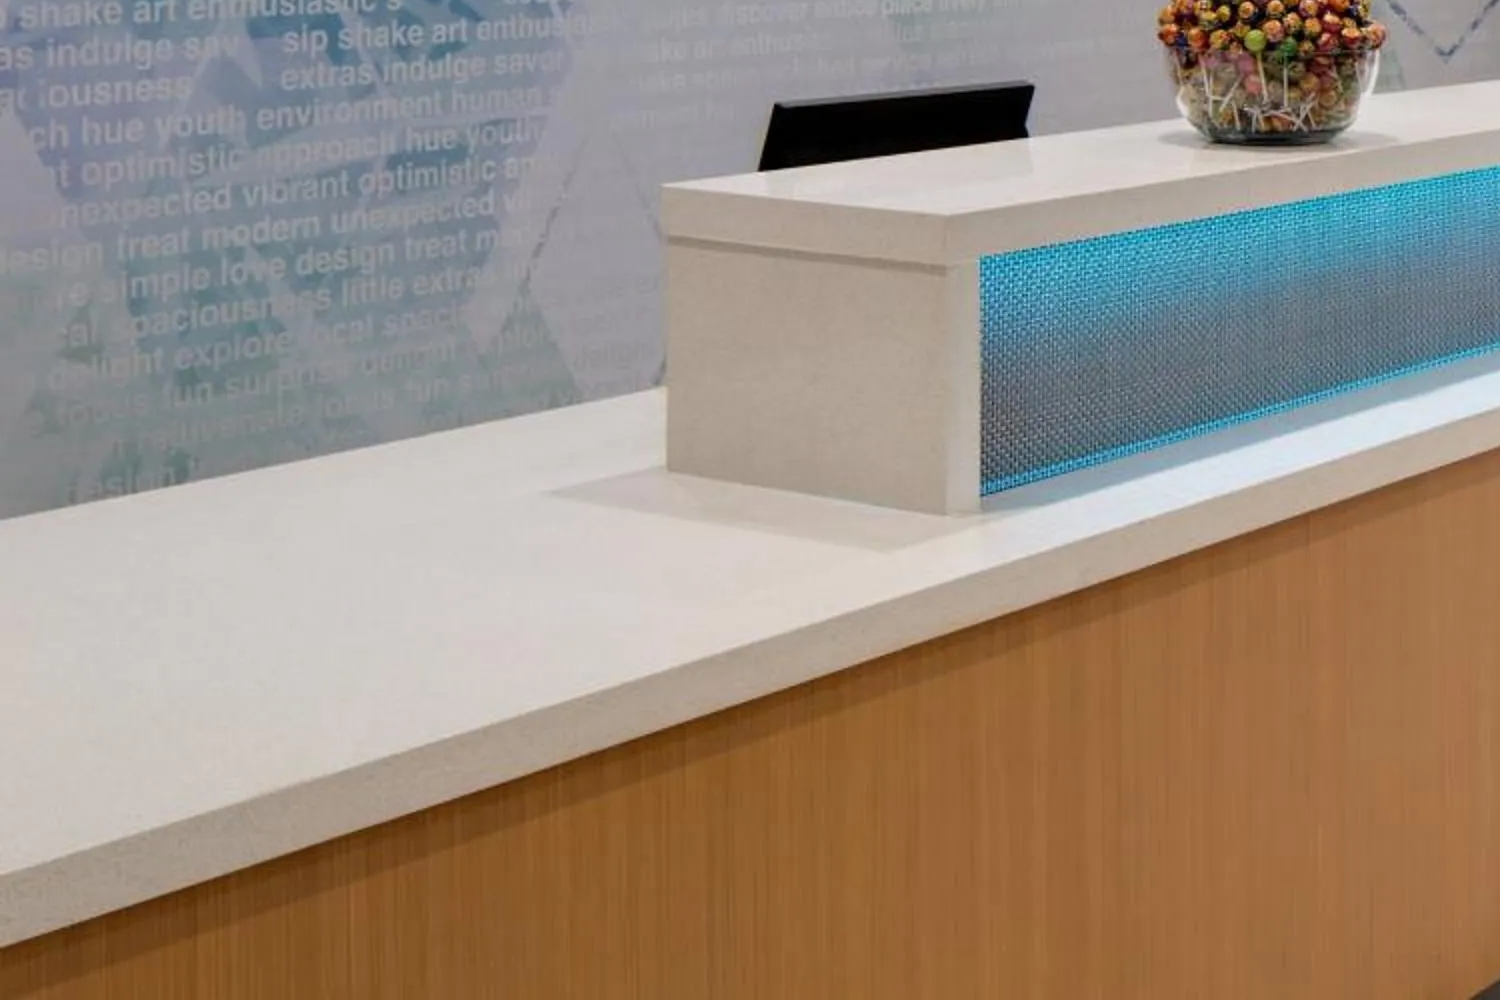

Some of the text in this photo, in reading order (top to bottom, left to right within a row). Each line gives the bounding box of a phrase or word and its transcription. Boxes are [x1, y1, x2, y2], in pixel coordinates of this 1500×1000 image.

[19, 0, 124, 28] shake
[46, 33, 174, 71] indulge
[282, 15, 469, 61] sip shake art
[280, 61, 374, 92] extras
[384, 50, 486, 84] indulge
[81, 114, 146, 146] hue
[154, 103, 246, 152] youth
[257, 90, 444, 131] environment
[81, 142, 247, 192] optimistic
[406, 125, 458, 154] hue
[242, 170, 351, 207] vibrant
[358, 155, 497, 199] optimistic
[117, 225, 191, 262] treat
[202, 213, 321, 248] modern
[221, 256, 287, 287] love
[295, 243, 395, 276] design
[405, 230, 467, 261] treat
[342, 276, 405, 308] little
[173, 329, 294, 373] explore
